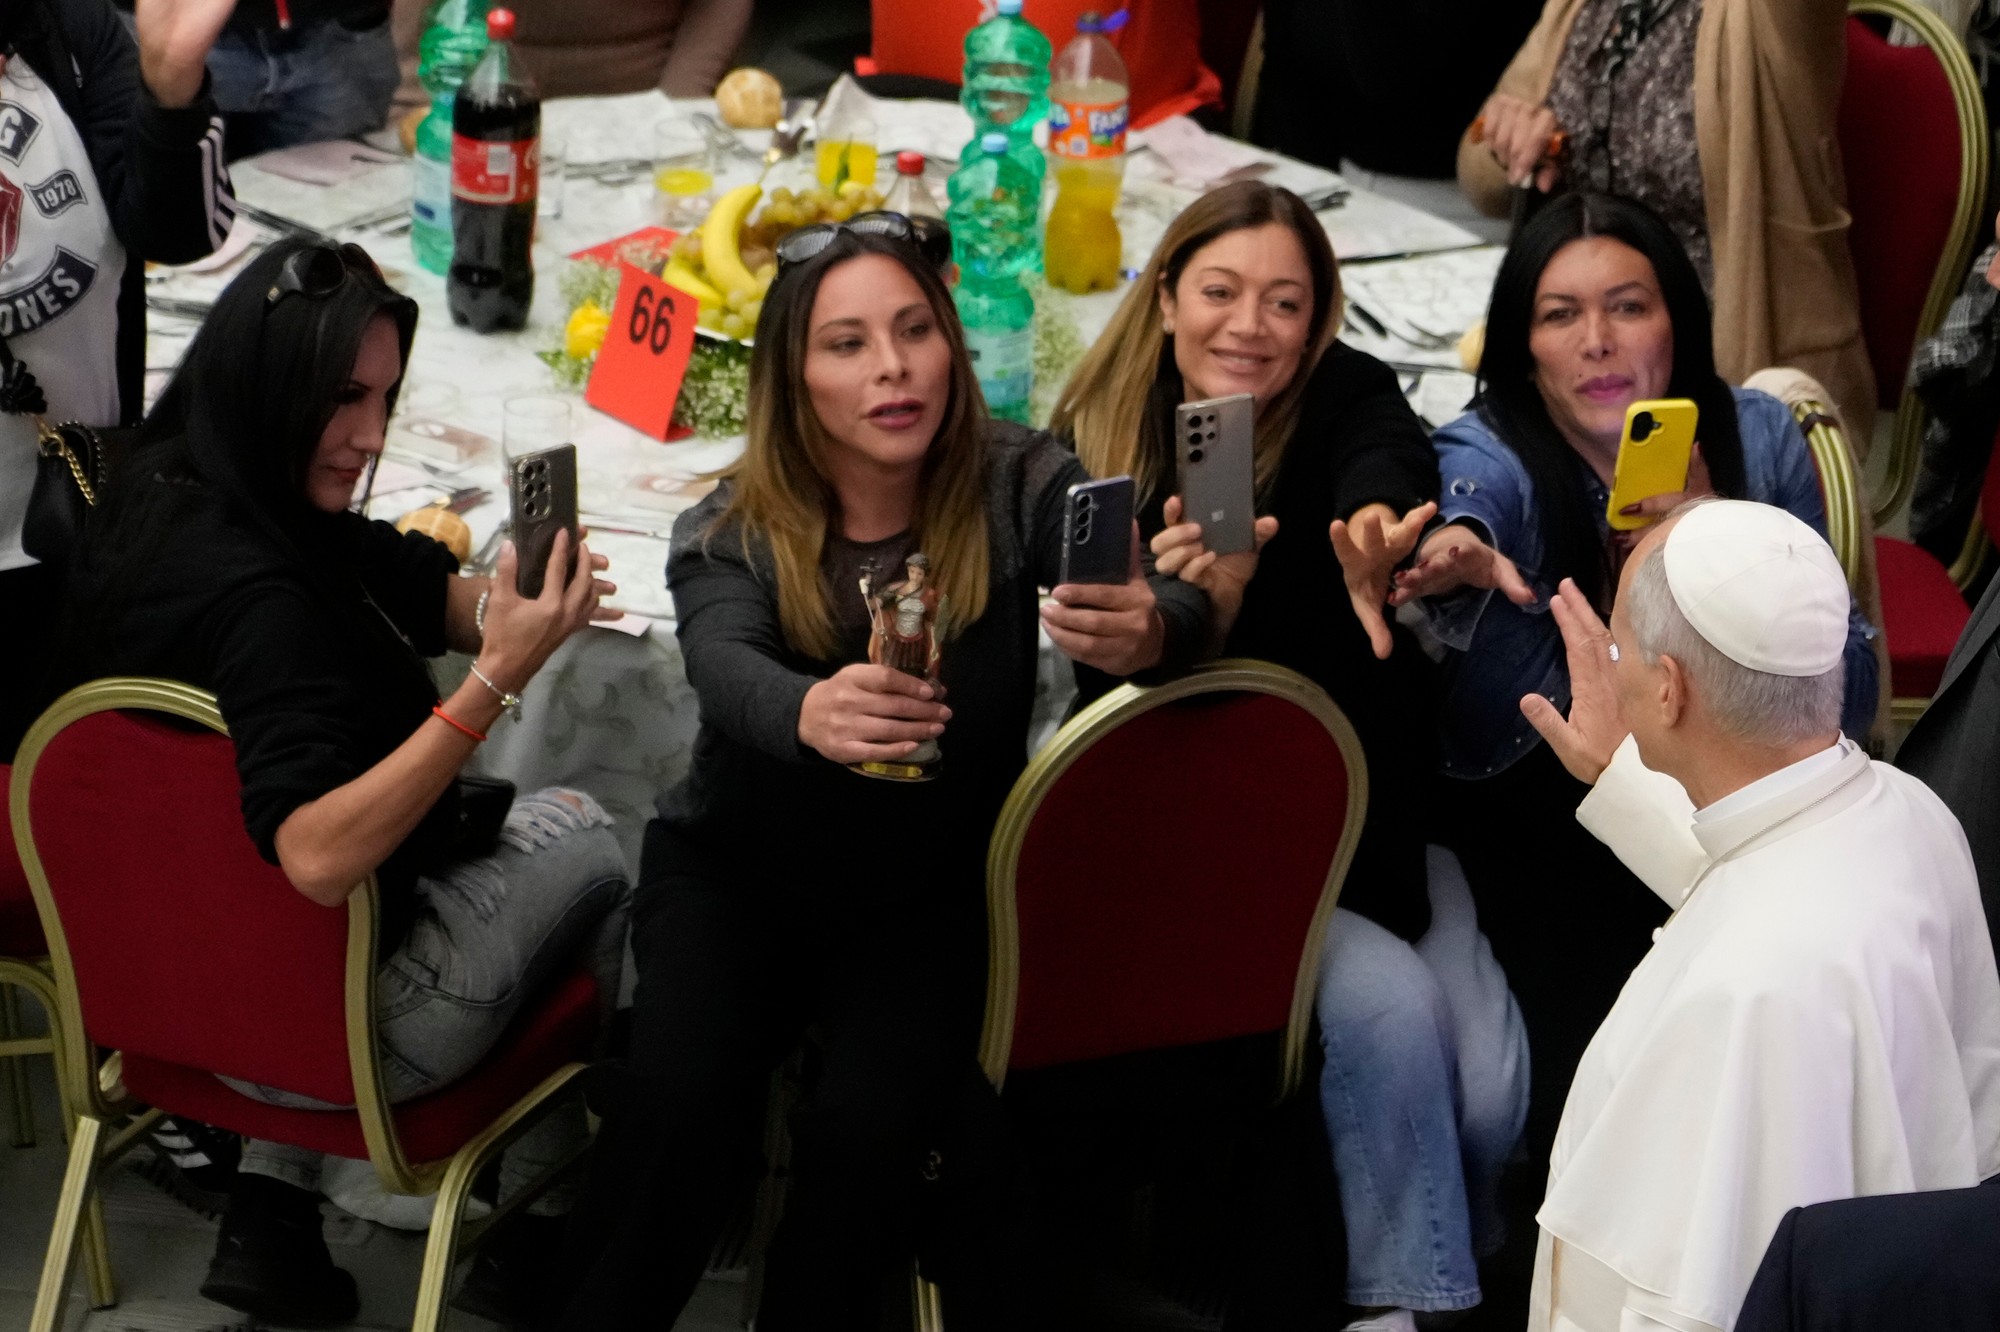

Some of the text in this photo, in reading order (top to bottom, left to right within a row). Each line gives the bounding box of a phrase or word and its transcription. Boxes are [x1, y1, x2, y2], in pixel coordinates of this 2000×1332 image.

[38, 179, 77, 209] 1978
[0, 267, 80, 337] ONES
[630, 285, 675, 356] 66
